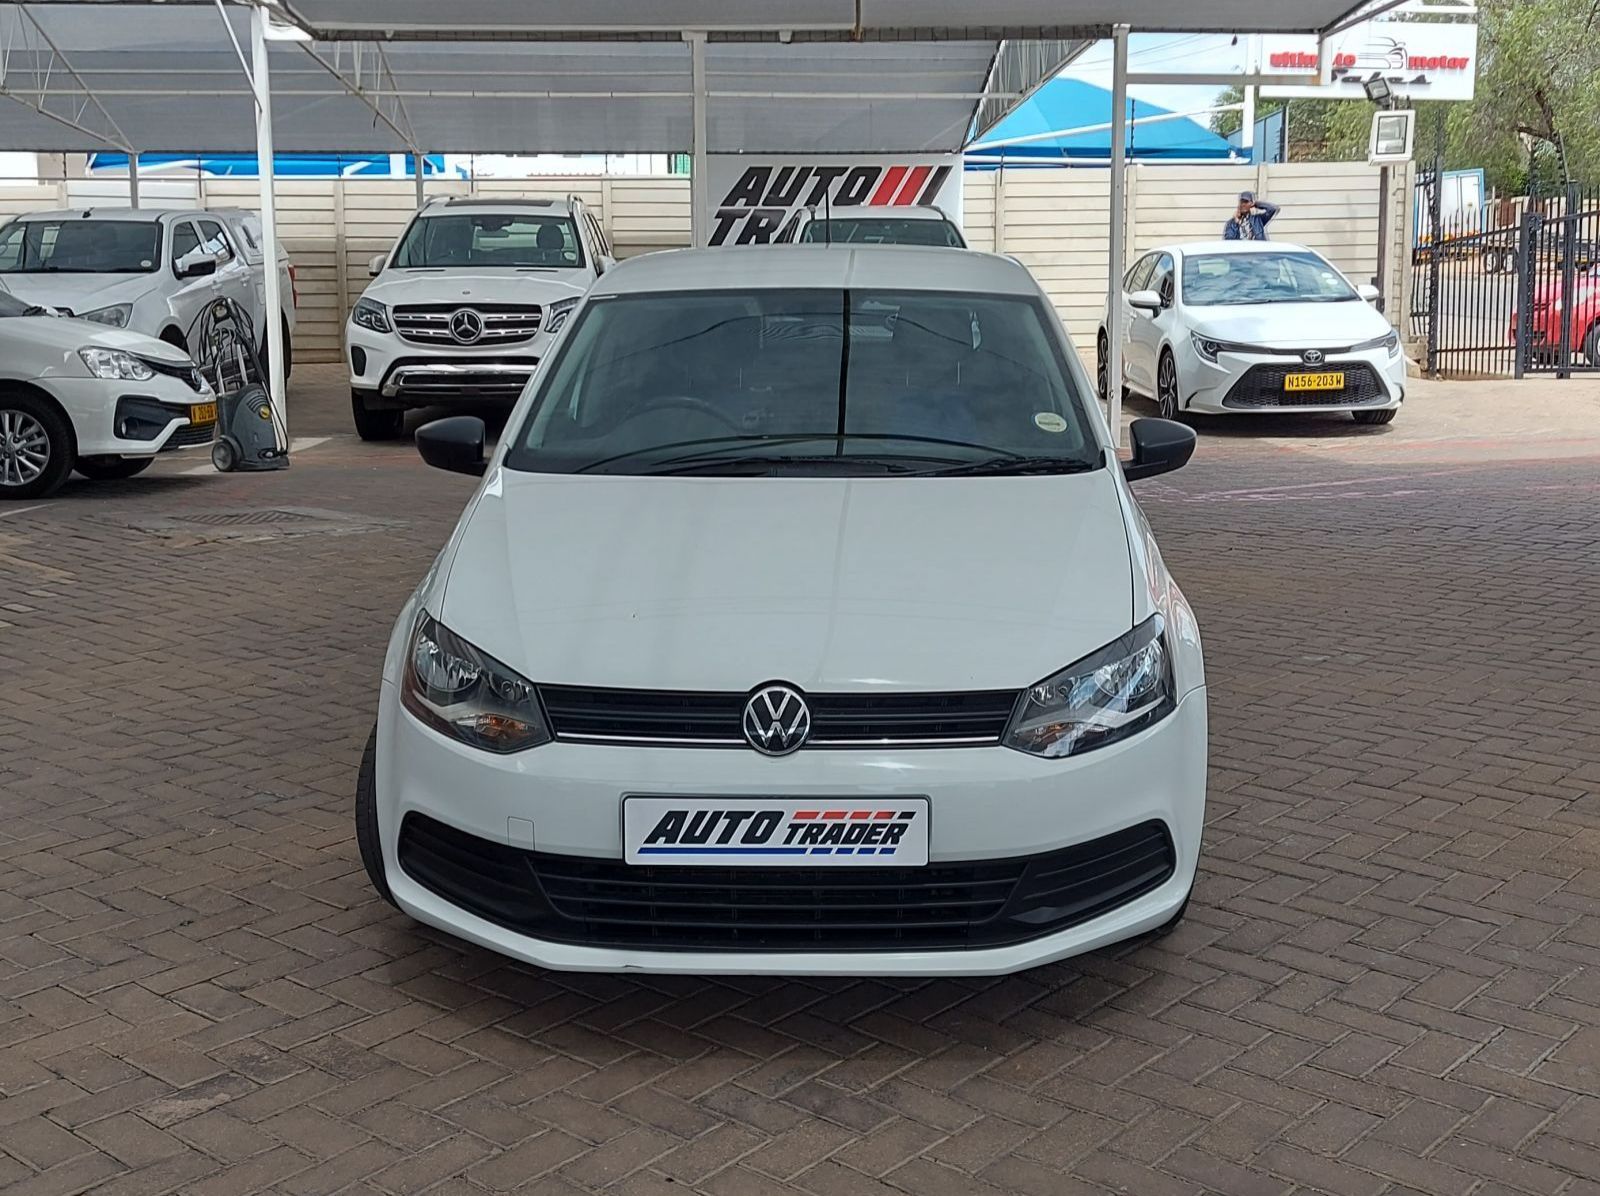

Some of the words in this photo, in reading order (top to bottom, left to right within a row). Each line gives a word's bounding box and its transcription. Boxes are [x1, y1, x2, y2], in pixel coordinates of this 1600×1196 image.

[1269, 51, 1356, 68] ultimte
[1407, 54, 1470, 71] motor
[719, 165, 883, 207] AUTO
[642, 810, 786, 845] AUTO
[781, 822, 910, 845] TRADER
